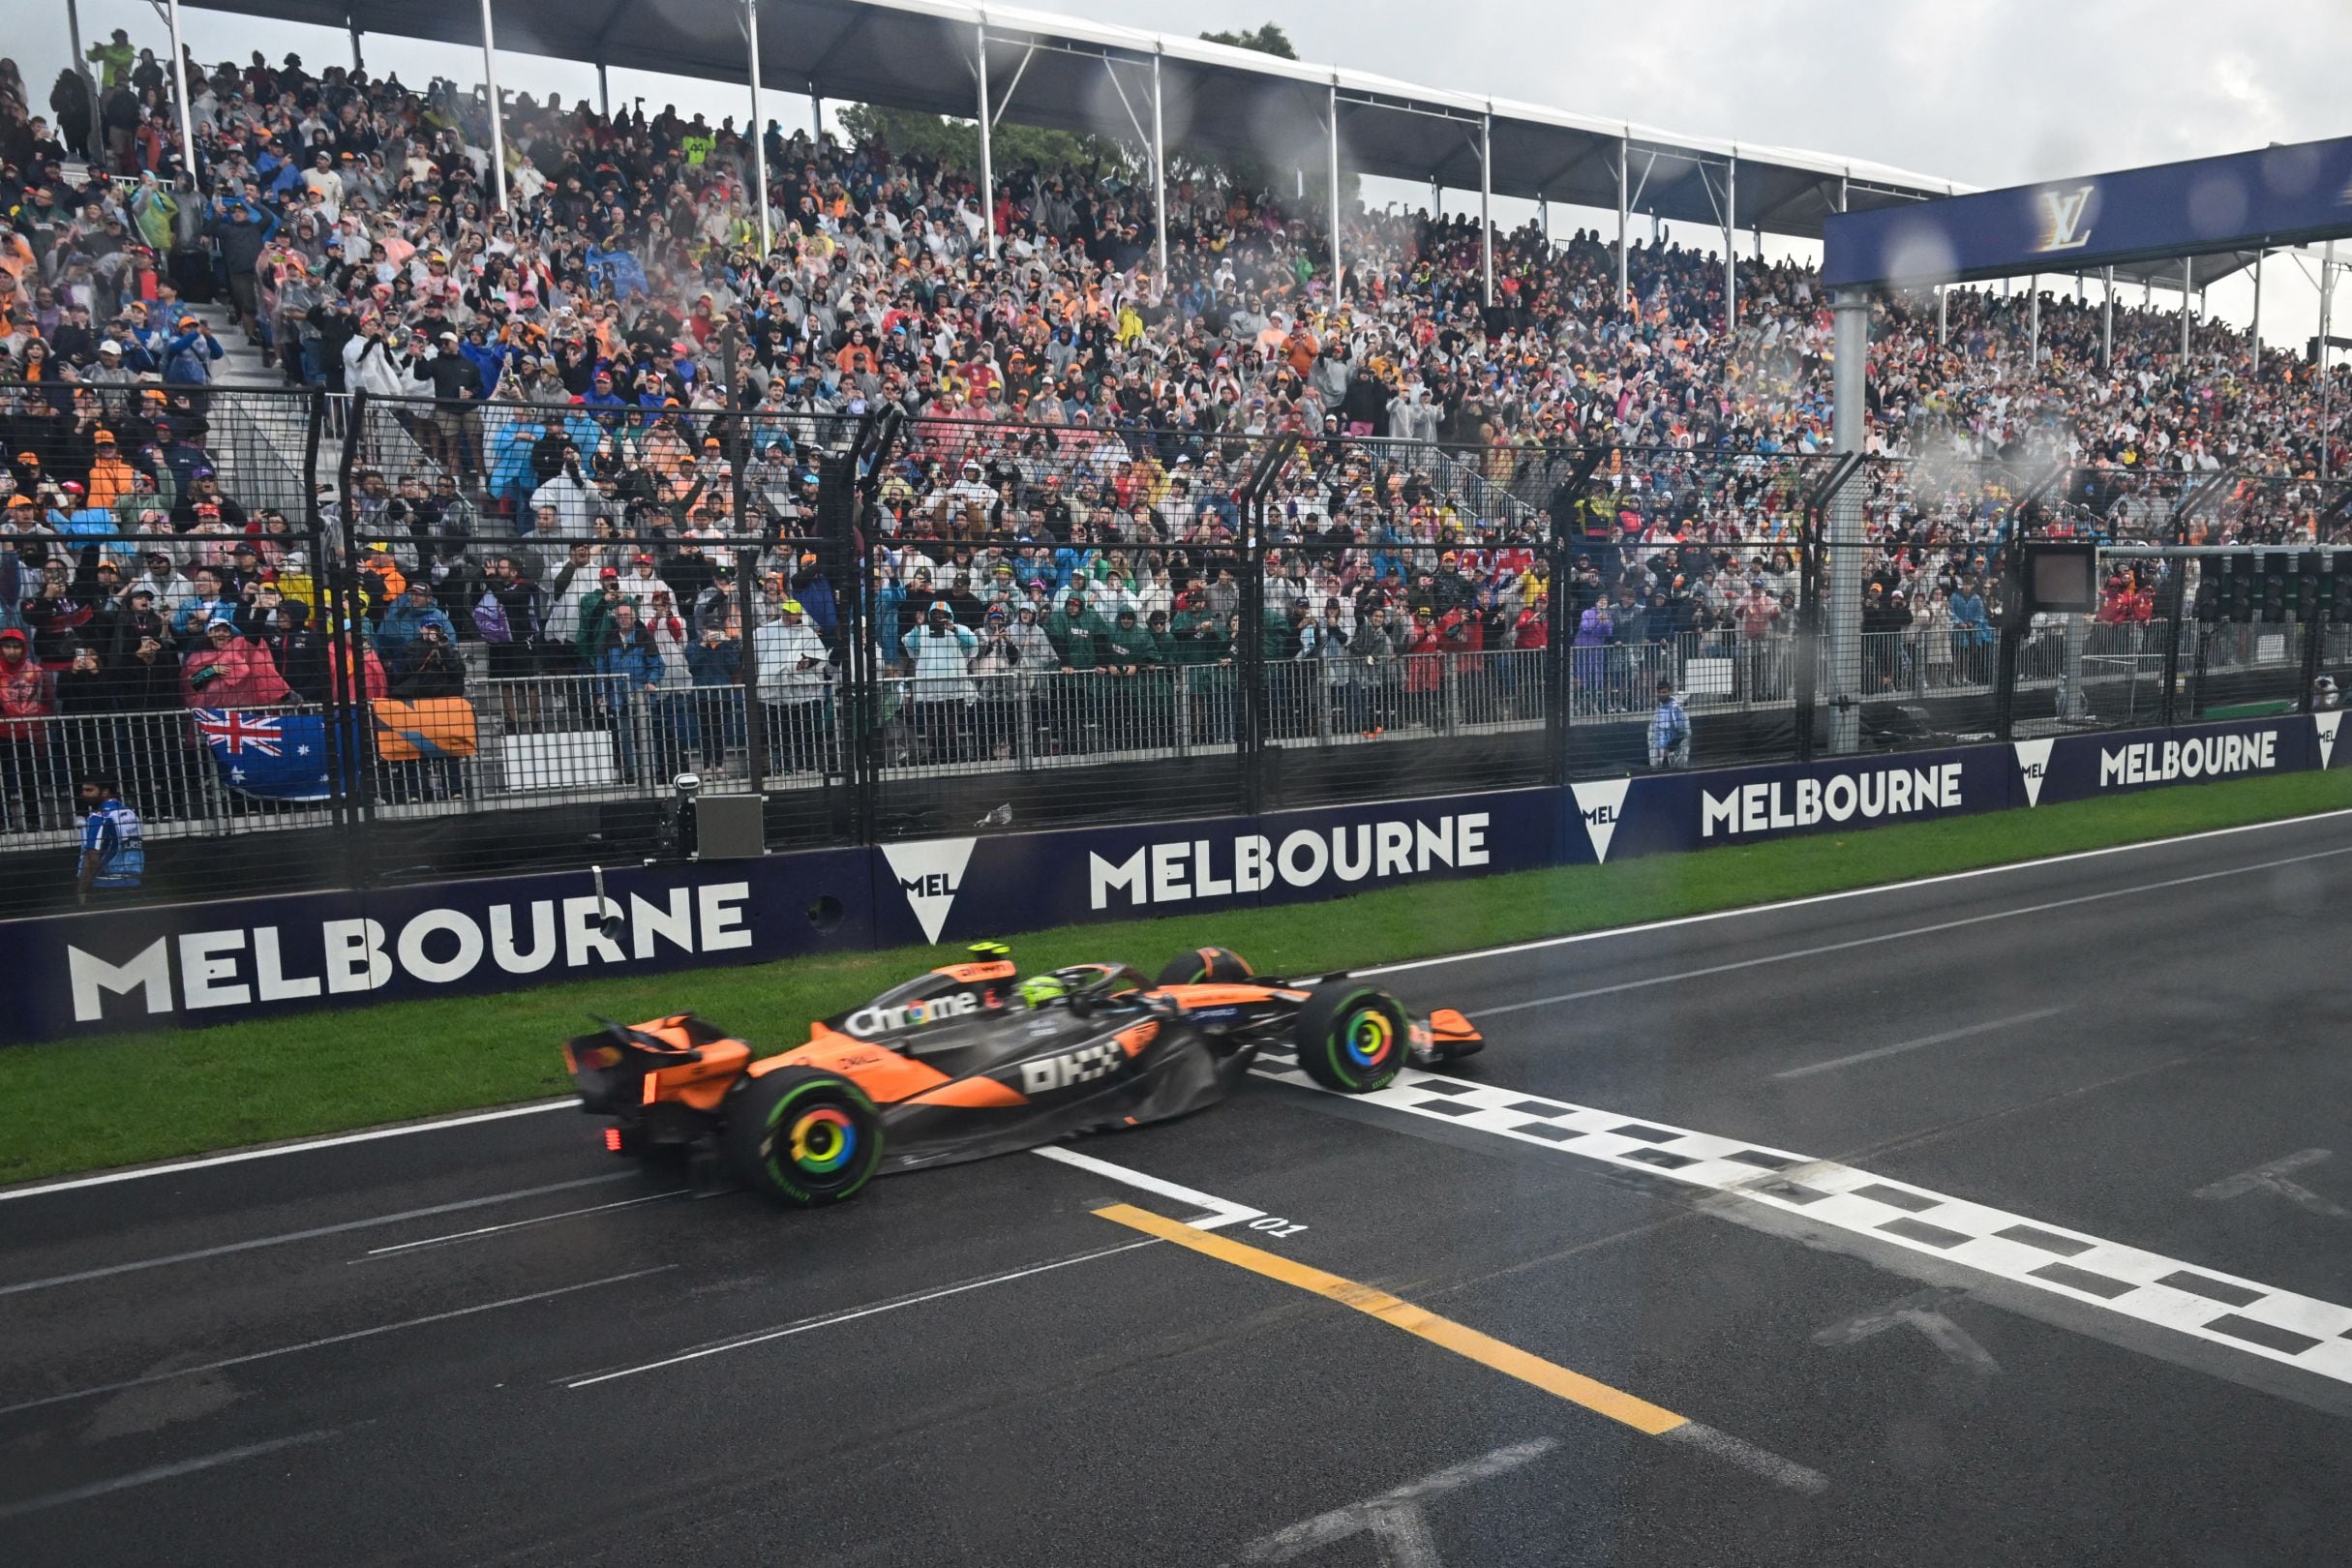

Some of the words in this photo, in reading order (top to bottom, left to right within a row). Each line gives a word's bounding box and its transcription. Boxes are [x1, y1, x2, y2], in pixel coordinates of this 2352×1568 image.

[2318, 730, 2336, 742] MEL
[2021, 763, 2045, 779] MEL
[2100, 732, 2277, 787] MELBOURNE
[1582, 805, 1619, 826] MEL
[1703, 763, 1962, 837] MELBOURNE
[1089, 812, 1490, 910] MELBOURNE
[900, 873, 958, 898] MEL
[68, 881, 752, 1022] MELBOURNE
[1020, 1040, 1122, 1095] OKX
[1248, 1217, 1309, 1238] 01
